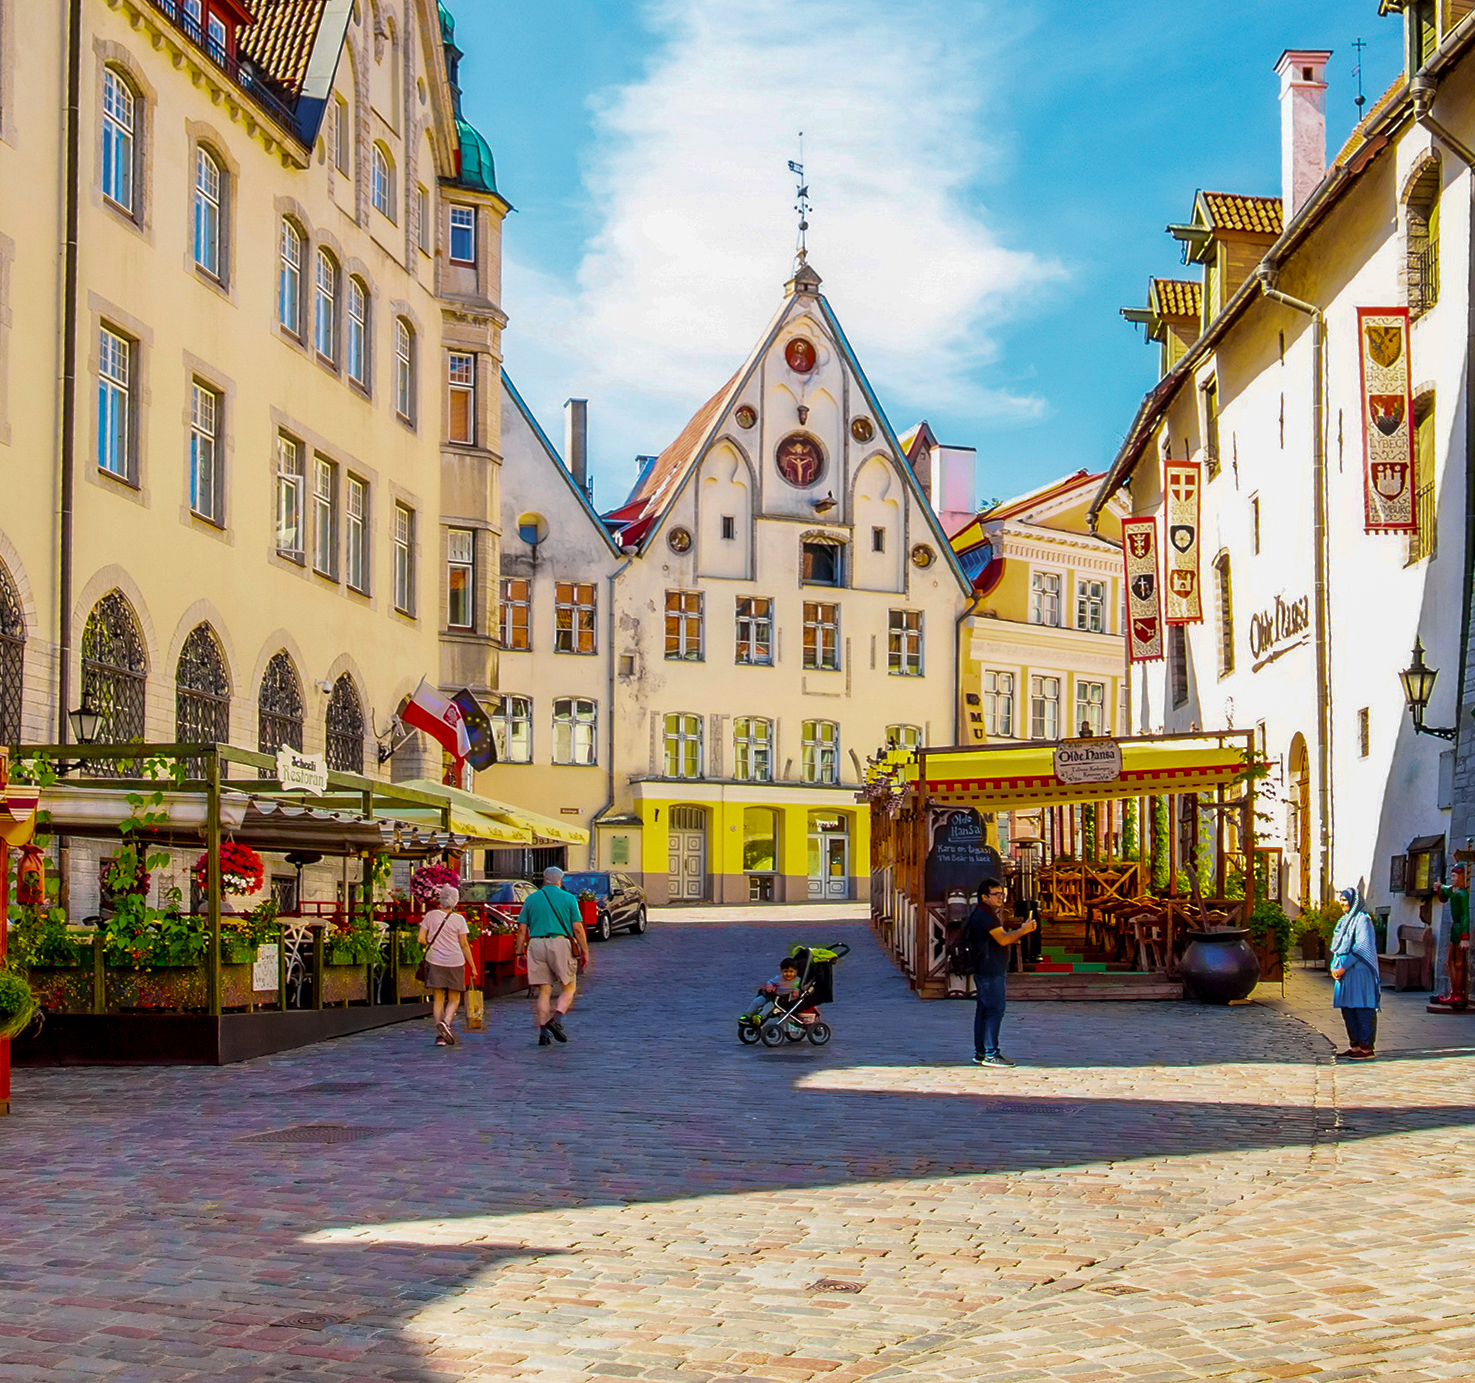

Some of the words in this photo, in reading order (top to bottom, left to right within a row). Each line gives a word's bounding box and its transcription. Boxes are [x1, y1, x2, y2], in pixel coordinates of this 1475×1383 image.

[1058, 750, 1084, 763] Olde
[1083, 748, 1115, 761] Hansa
[283, 765, 324, 787] Restoran
[951, 814, 972, 826] Olde
[937, 844, 956, 853] Karu
[937, 854, 951, 862] The
